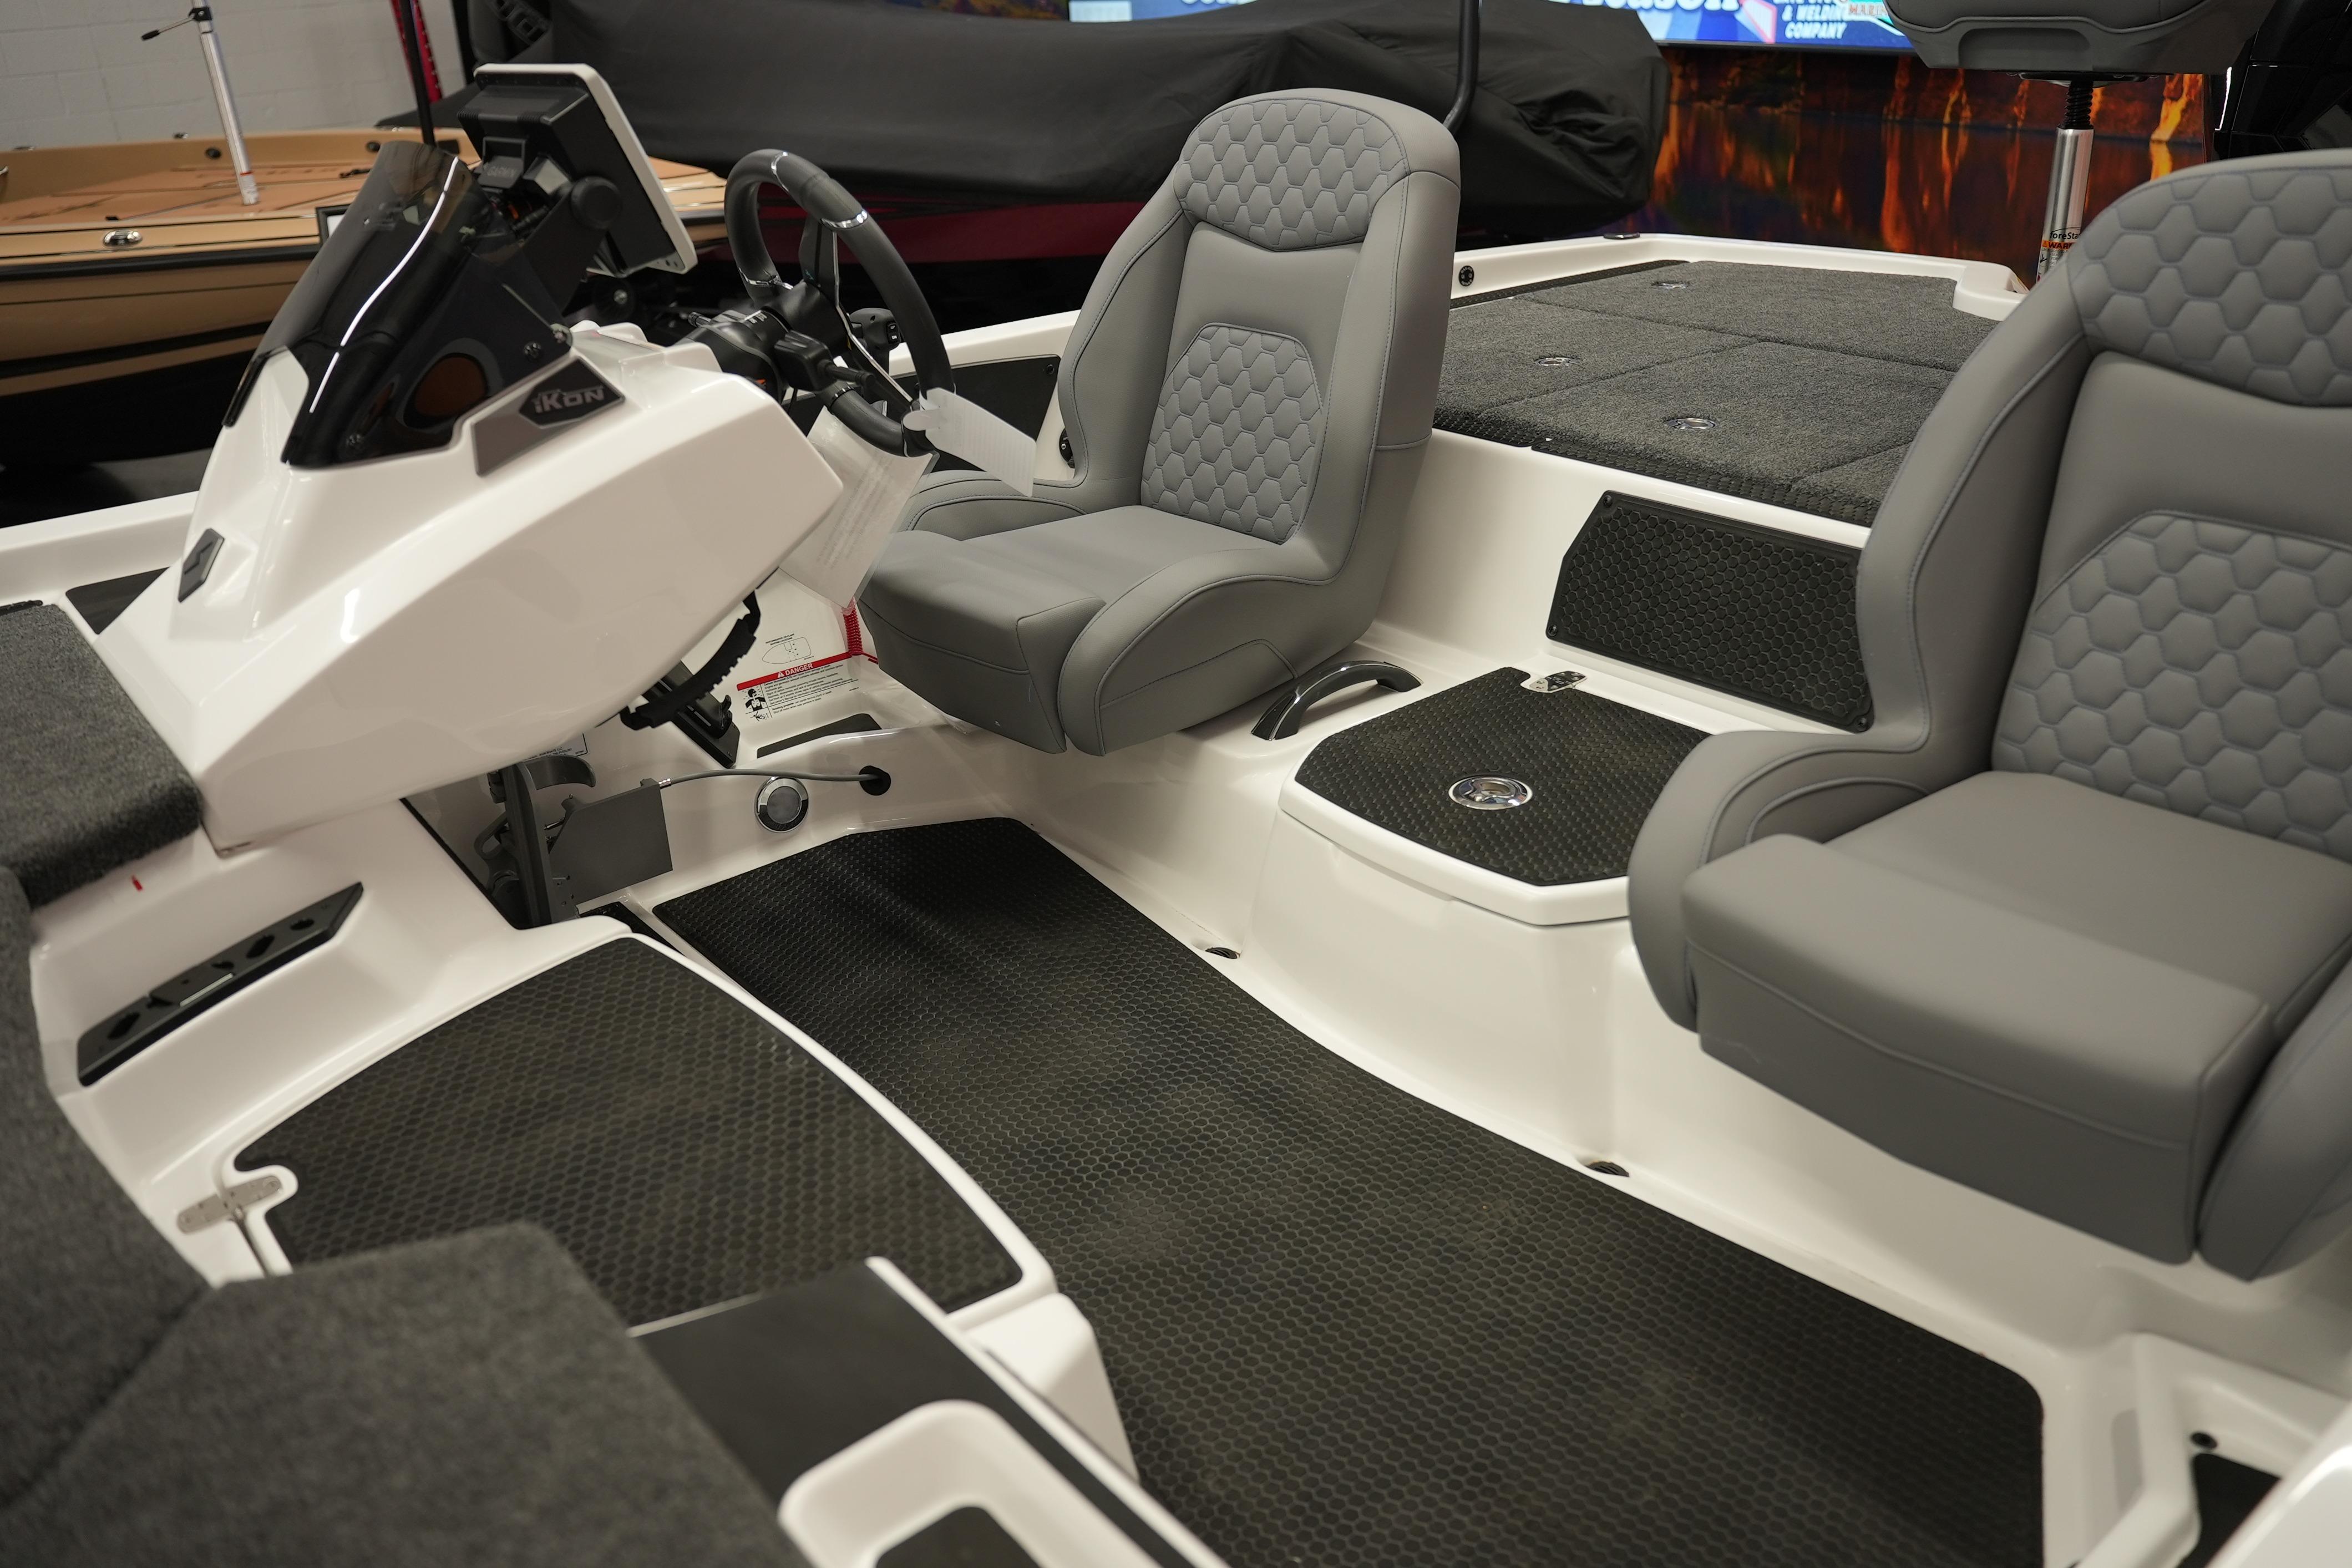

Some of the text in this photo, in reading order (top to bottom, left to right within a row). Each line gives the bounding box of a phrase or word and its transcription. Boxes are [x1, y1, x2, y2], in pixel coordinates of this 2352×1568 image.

[1785, 22, 1847, 39] COMPANY
[2050, 231, 2081, 240] foreSta
[785, 663, 813, 676] DANGER
